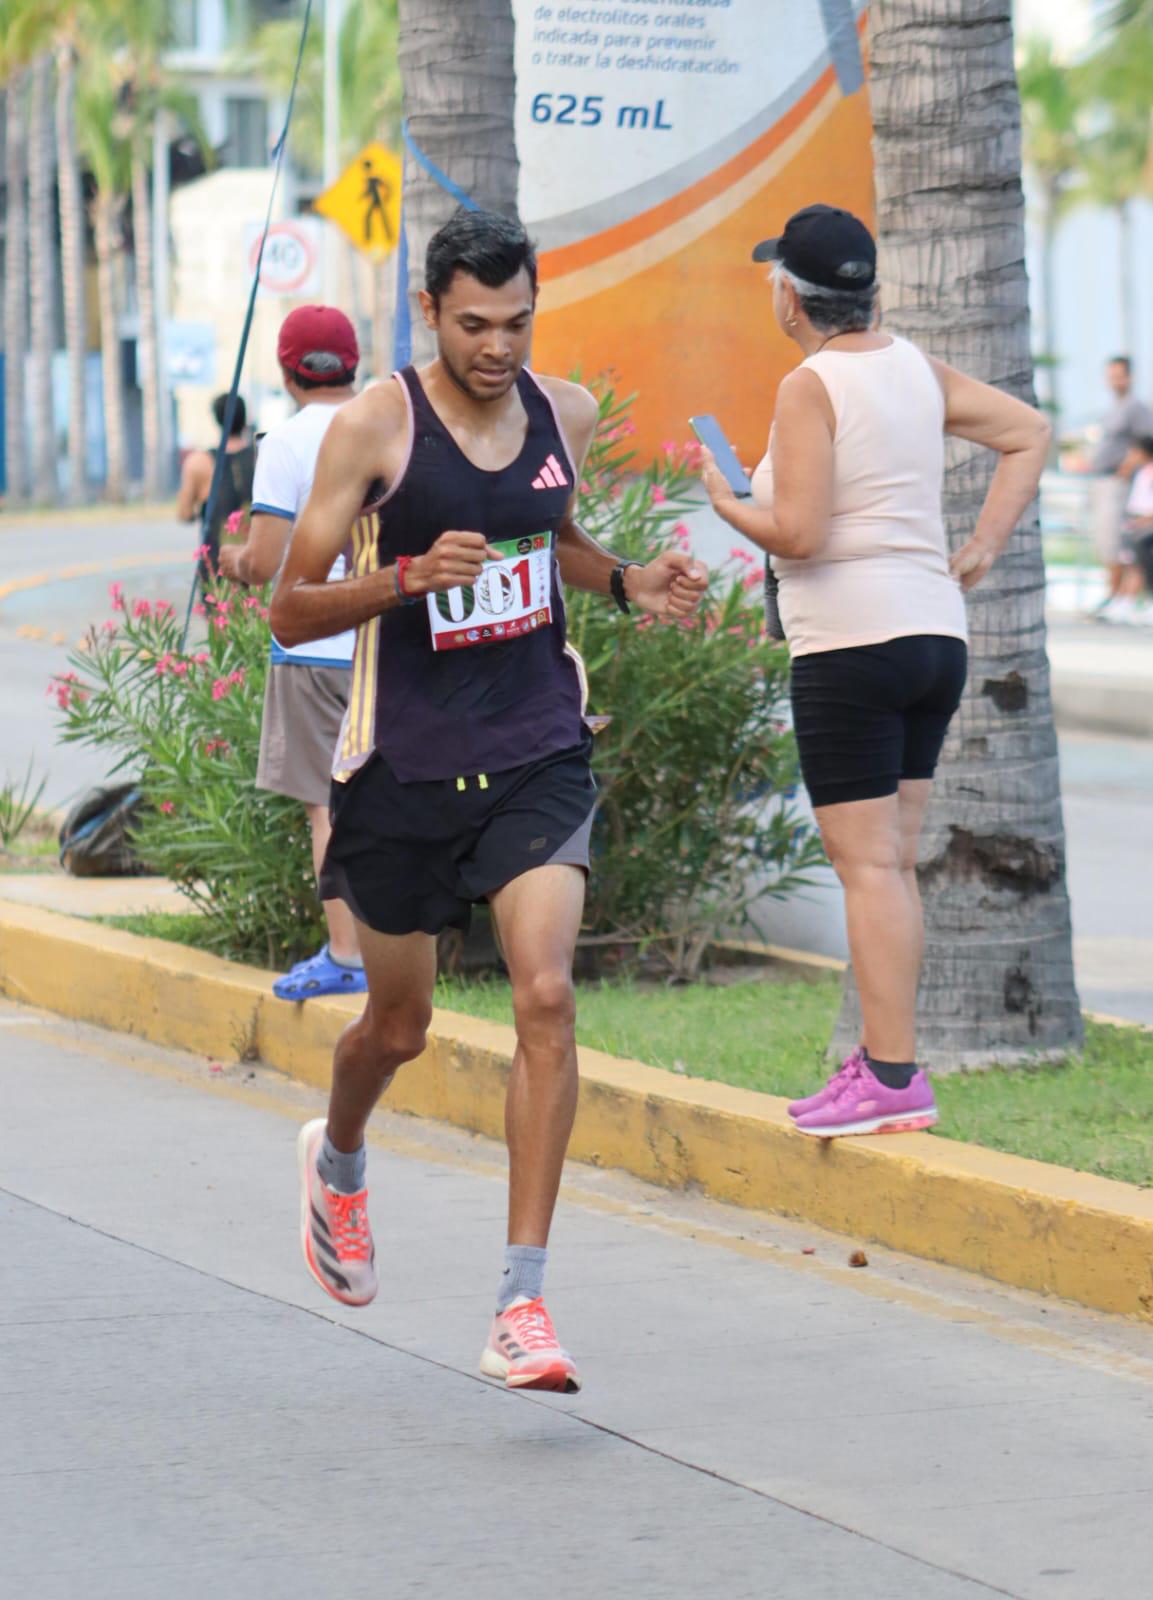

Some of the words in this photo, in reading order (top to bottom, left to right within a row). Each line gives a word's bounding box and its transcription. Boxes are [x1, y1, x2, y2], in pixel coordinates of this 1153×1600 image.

[533, 5, 553, 21] de
[557, 8, 649, 26] electrolitos
[654, 12, 706, 29] orales
[533, 26, 599, 46] indicada
[603, 34, 641, 50] para
[646, 34, 717, 52] prevenir
[531, 52, 541, 66] o
[546, 50, 591, 67] tratar
[596, 50, 611, 69] la
[616, 54, 739, 75] deshidratación
[531, 92, 604, 126] 625
[617, 97, 673, 131] mL
